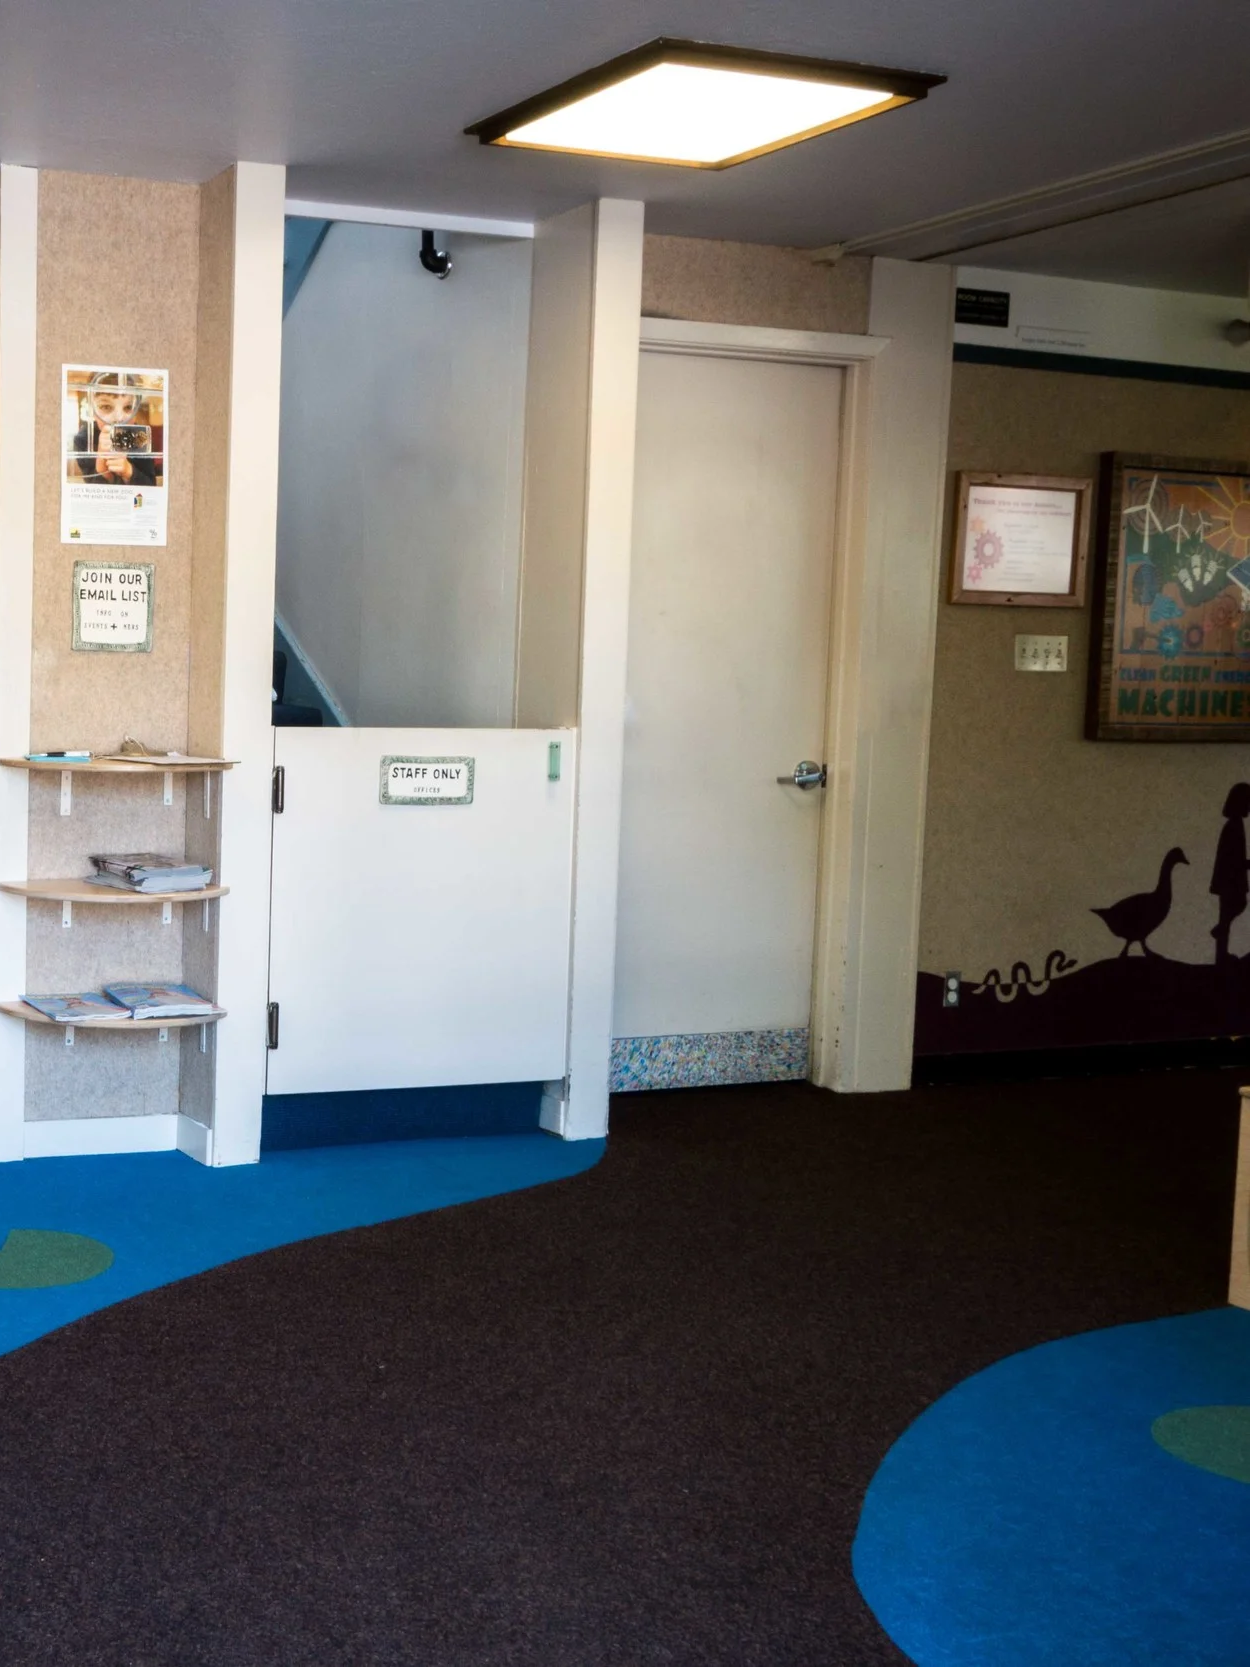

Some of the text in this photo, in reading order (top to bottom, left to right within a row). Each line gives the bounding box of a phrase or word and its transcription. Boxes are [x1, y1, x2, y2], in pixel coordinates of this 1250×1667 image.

[82, 572, 142, 585] JOIN OUR
[80, 588, 146, 602] EMAIL LIST
[1118, 688, 1250, 717] MACHINE
[392, 767, 461, 780] STAFF ONLY
